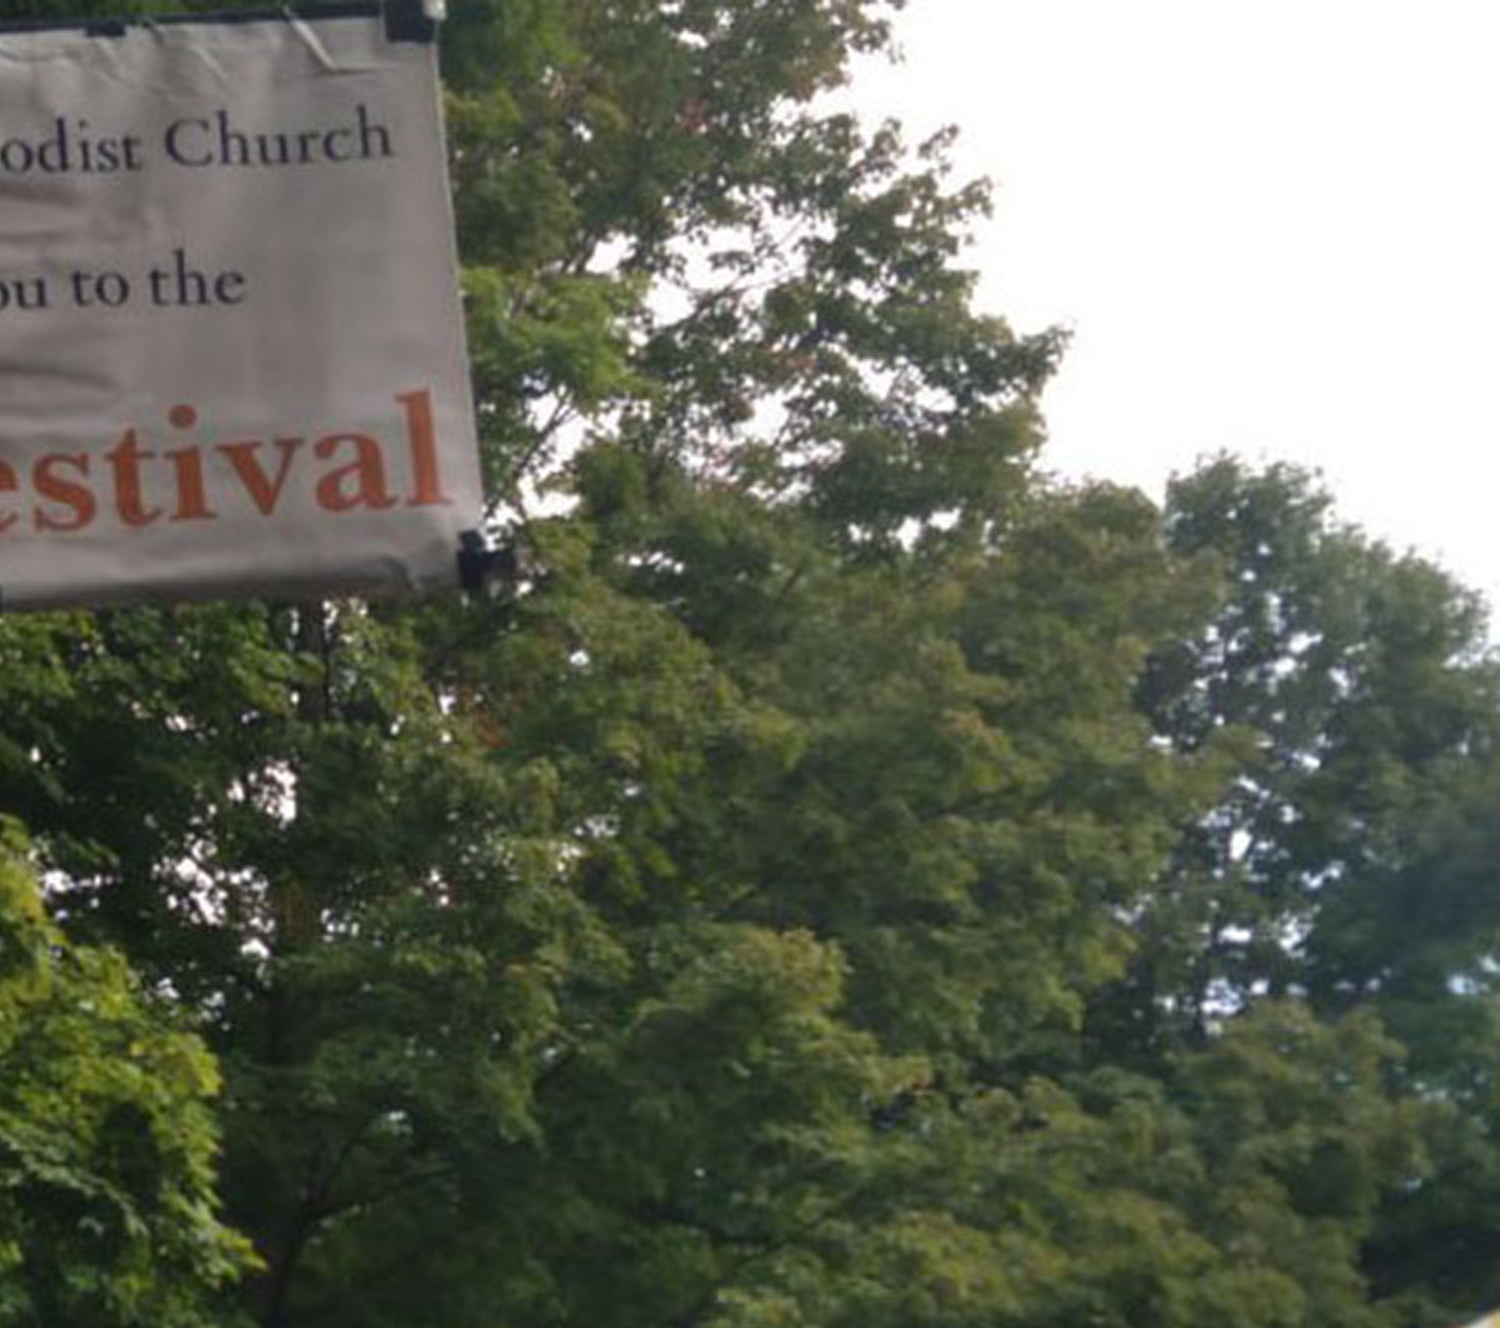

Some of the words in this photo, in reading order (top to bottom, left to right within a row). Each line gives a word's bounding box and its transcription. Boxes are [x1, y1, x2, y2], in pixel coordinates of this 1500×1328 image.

[164, 104, 393, 166] Church
[70, 266, 131, 308] to
[148, 248, 247, 308] the
